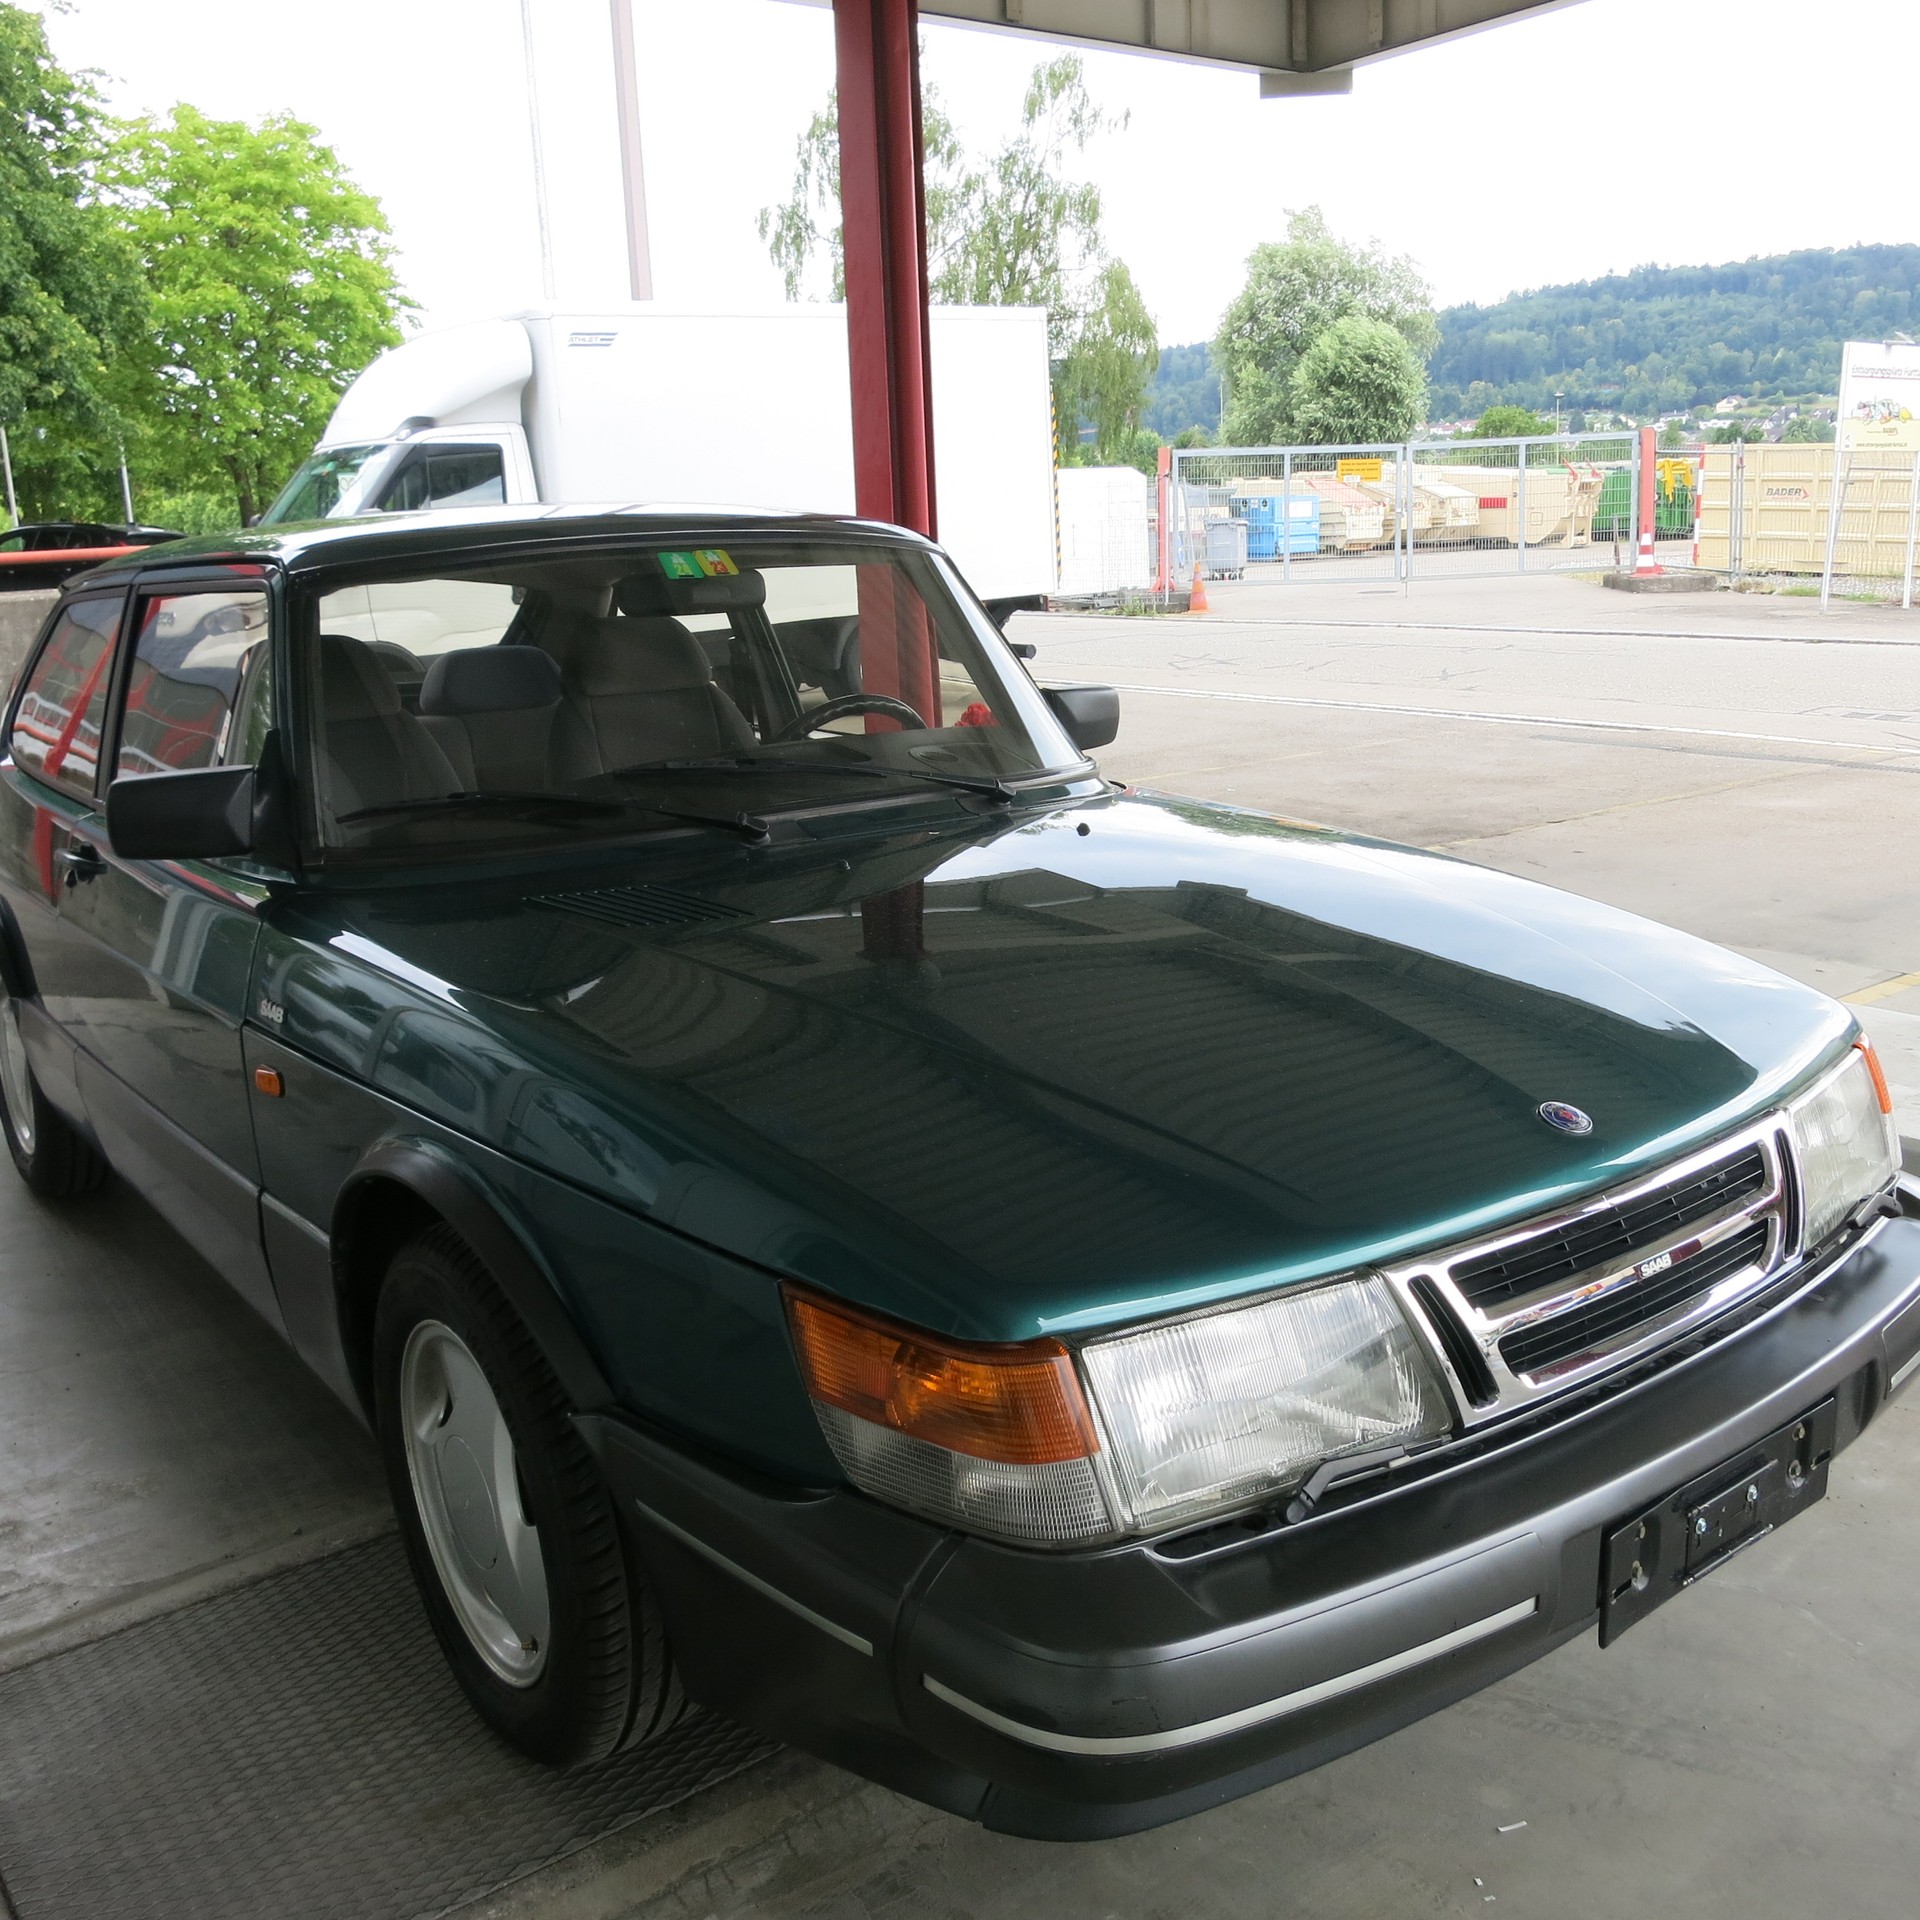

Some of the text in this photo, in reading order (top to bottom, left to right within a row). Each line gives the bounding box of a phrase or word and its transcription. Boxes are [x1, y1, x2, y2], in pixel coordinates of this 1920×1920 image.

[1766, 487, 1802, 496] BADER
[260, 998, 284, 1024] SAAB
[1640, 1253, 1672, 1278] SAAB
